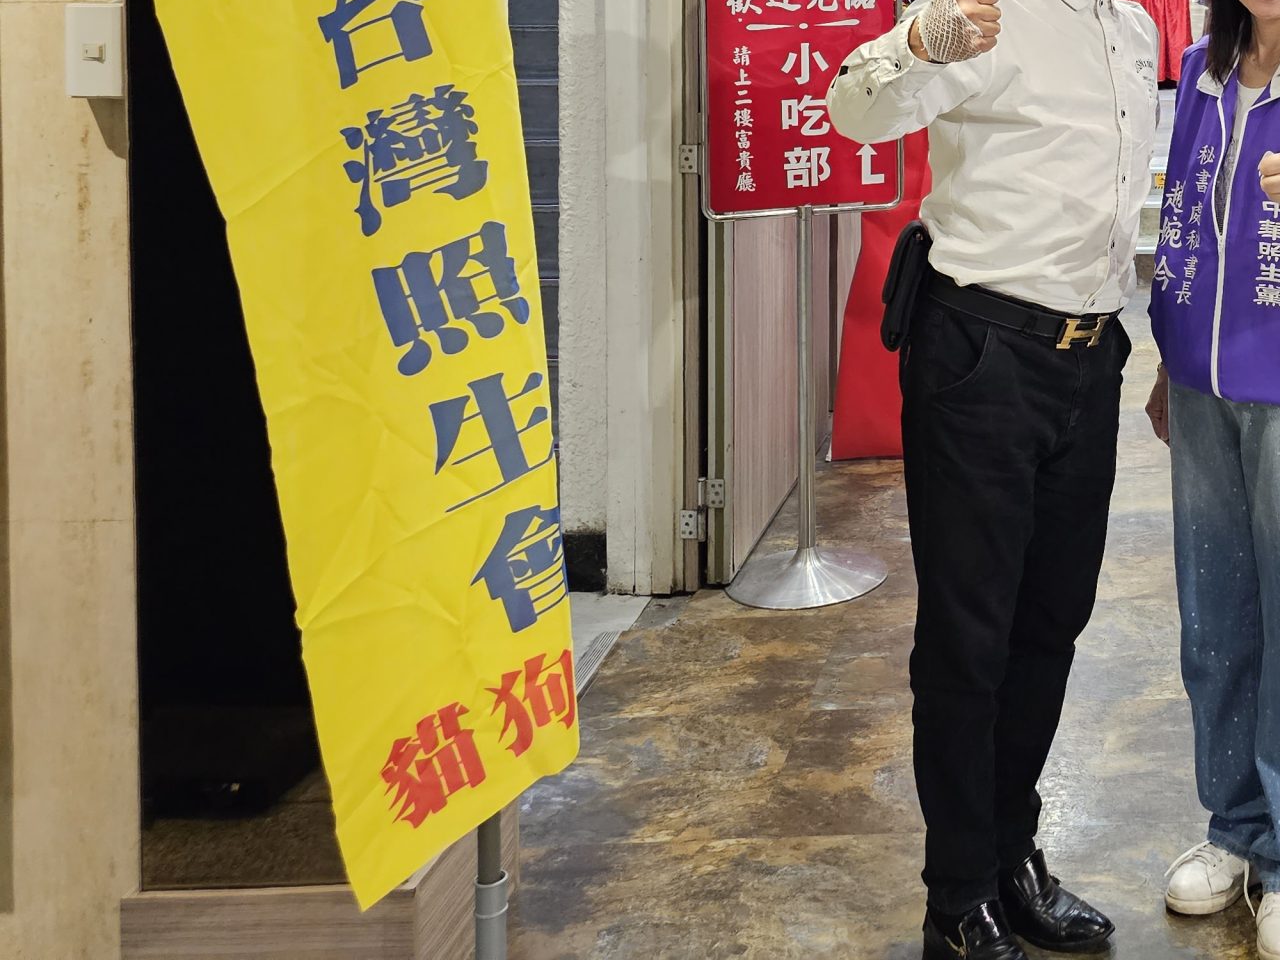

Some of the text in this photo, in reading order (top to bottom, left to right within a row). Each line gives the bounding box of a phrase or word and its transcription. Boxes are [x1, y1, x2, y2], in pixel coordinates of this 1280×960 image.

[732, 45, 756, 192] 請上二樓富貴廳
[780, 42, 832, 189] 小吃部
[379, 648, 575, 830] 貓狗
